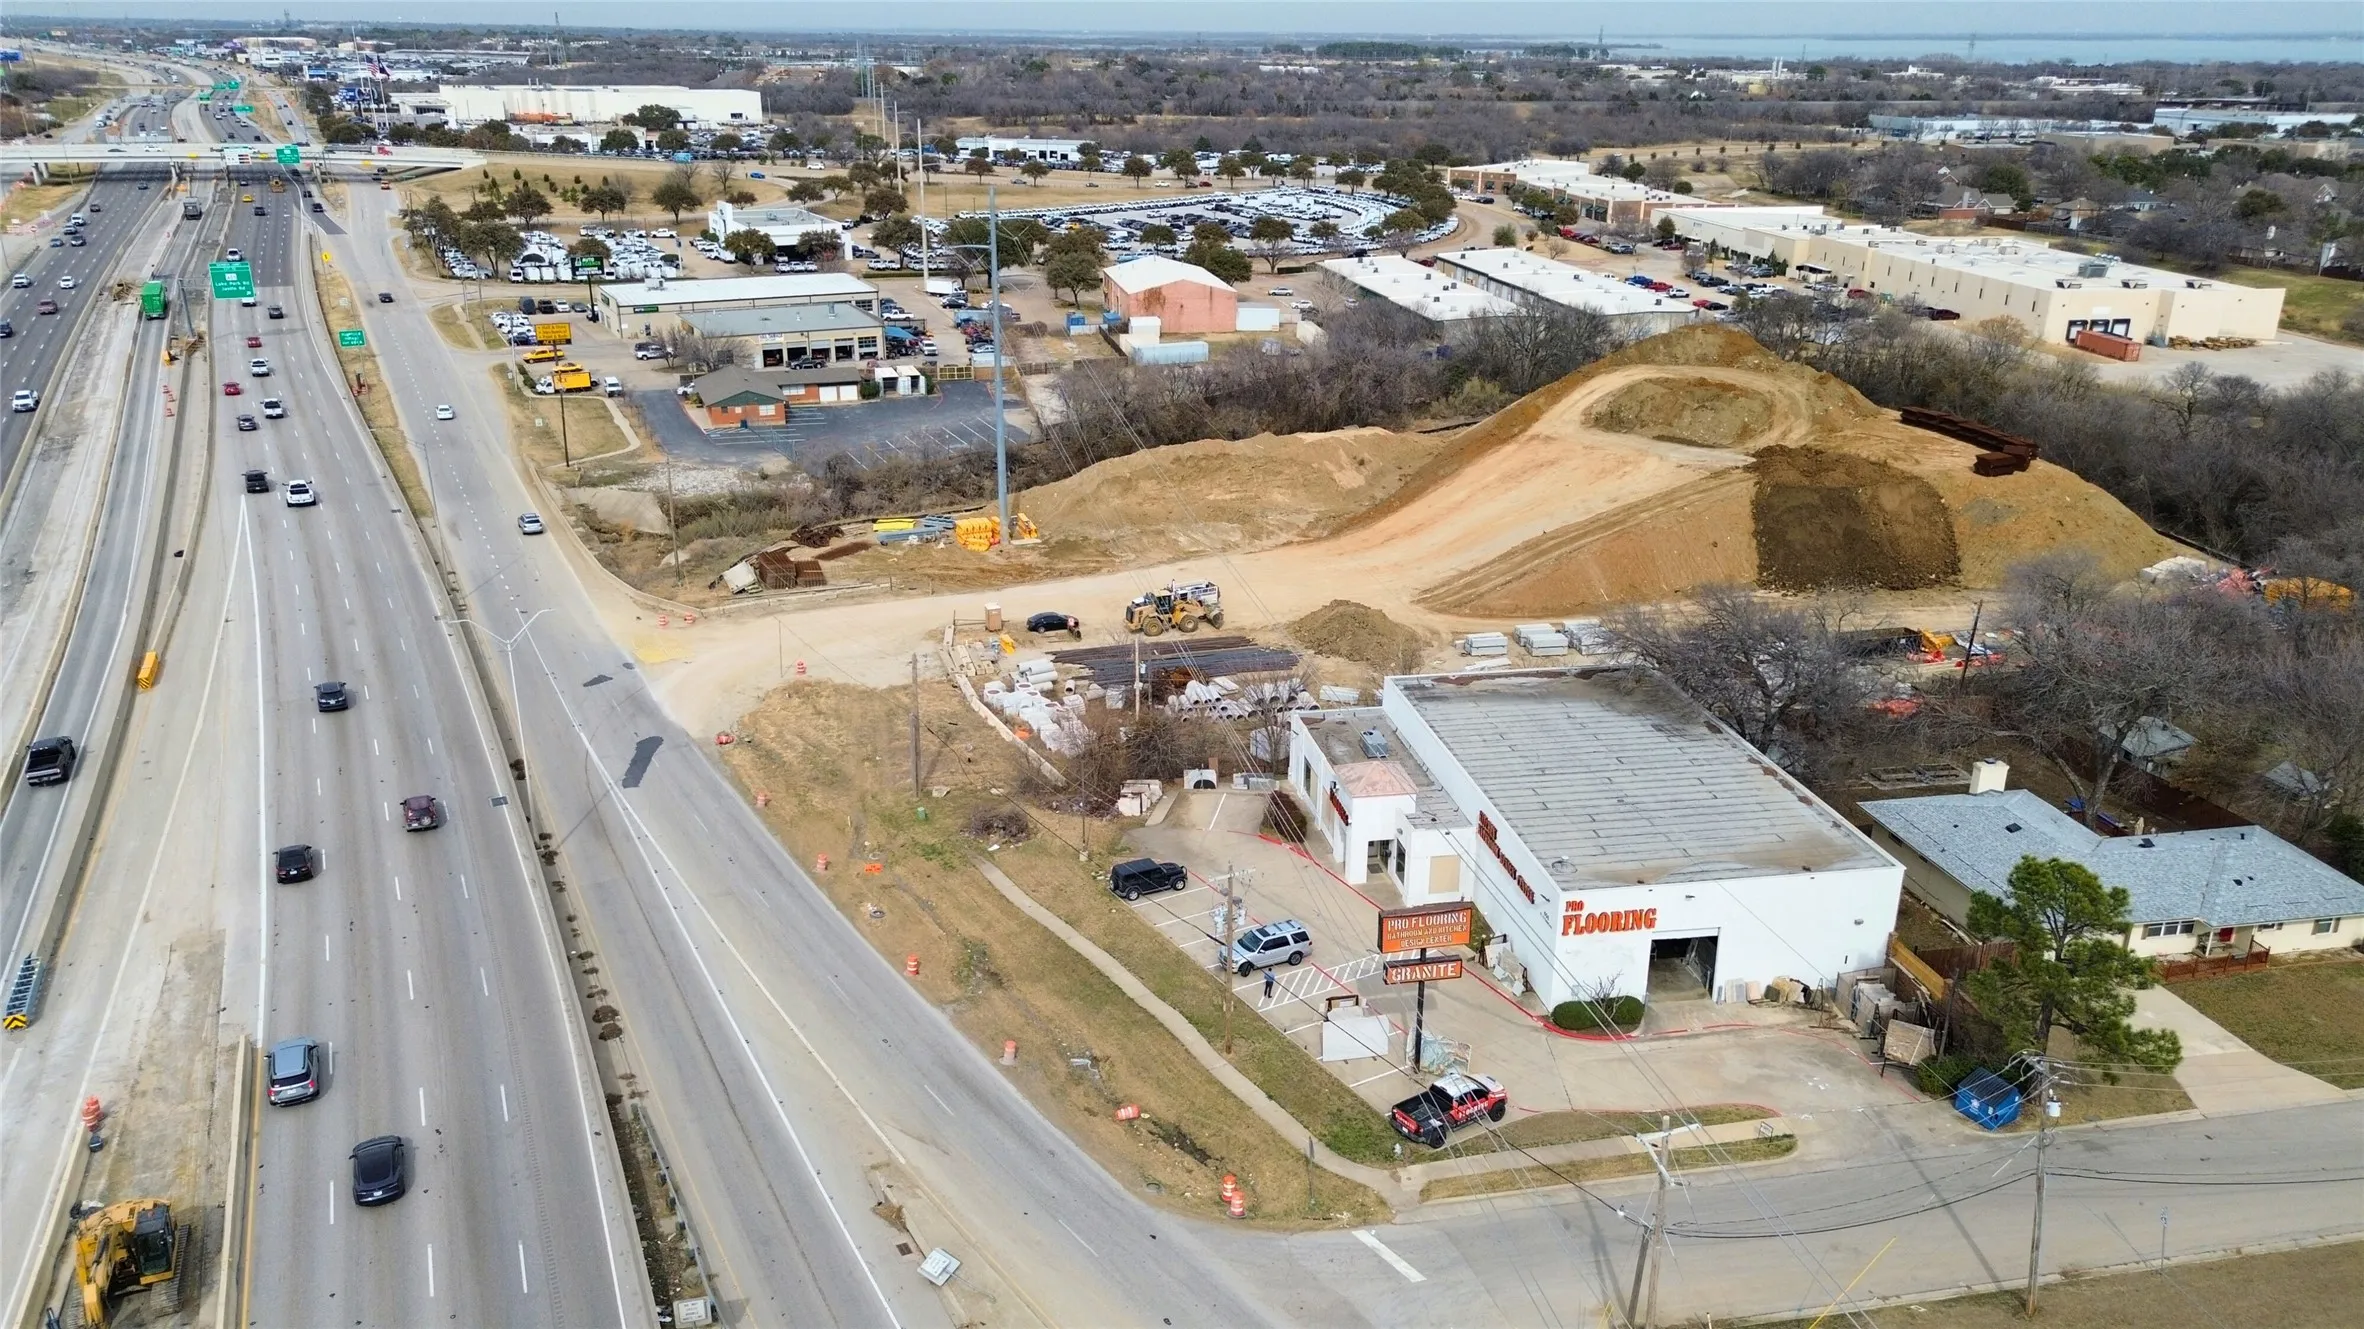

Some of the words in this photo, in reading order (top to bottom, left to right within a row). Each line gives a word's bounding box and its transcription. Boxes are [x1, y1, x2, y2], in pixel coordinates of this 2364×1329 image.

[1565, 900, 1584, 913] PRO
[1387, 918, 1409, 931] PRO
[1411, 911, 1467, 928] FLOORING
[1561, 907, 1657, 936] FLOORING
[1387, 928, 1423, 940] BATHROOM
[1424, 927, 1438, 935] AND
[1438, 924, 1467, 934] KITCHEN
[1400, 937, 1425, 948] DESIGN
[1425, 935, 1452, 944] CENTER
[1391, 963, 1457, 981] GRANITE
